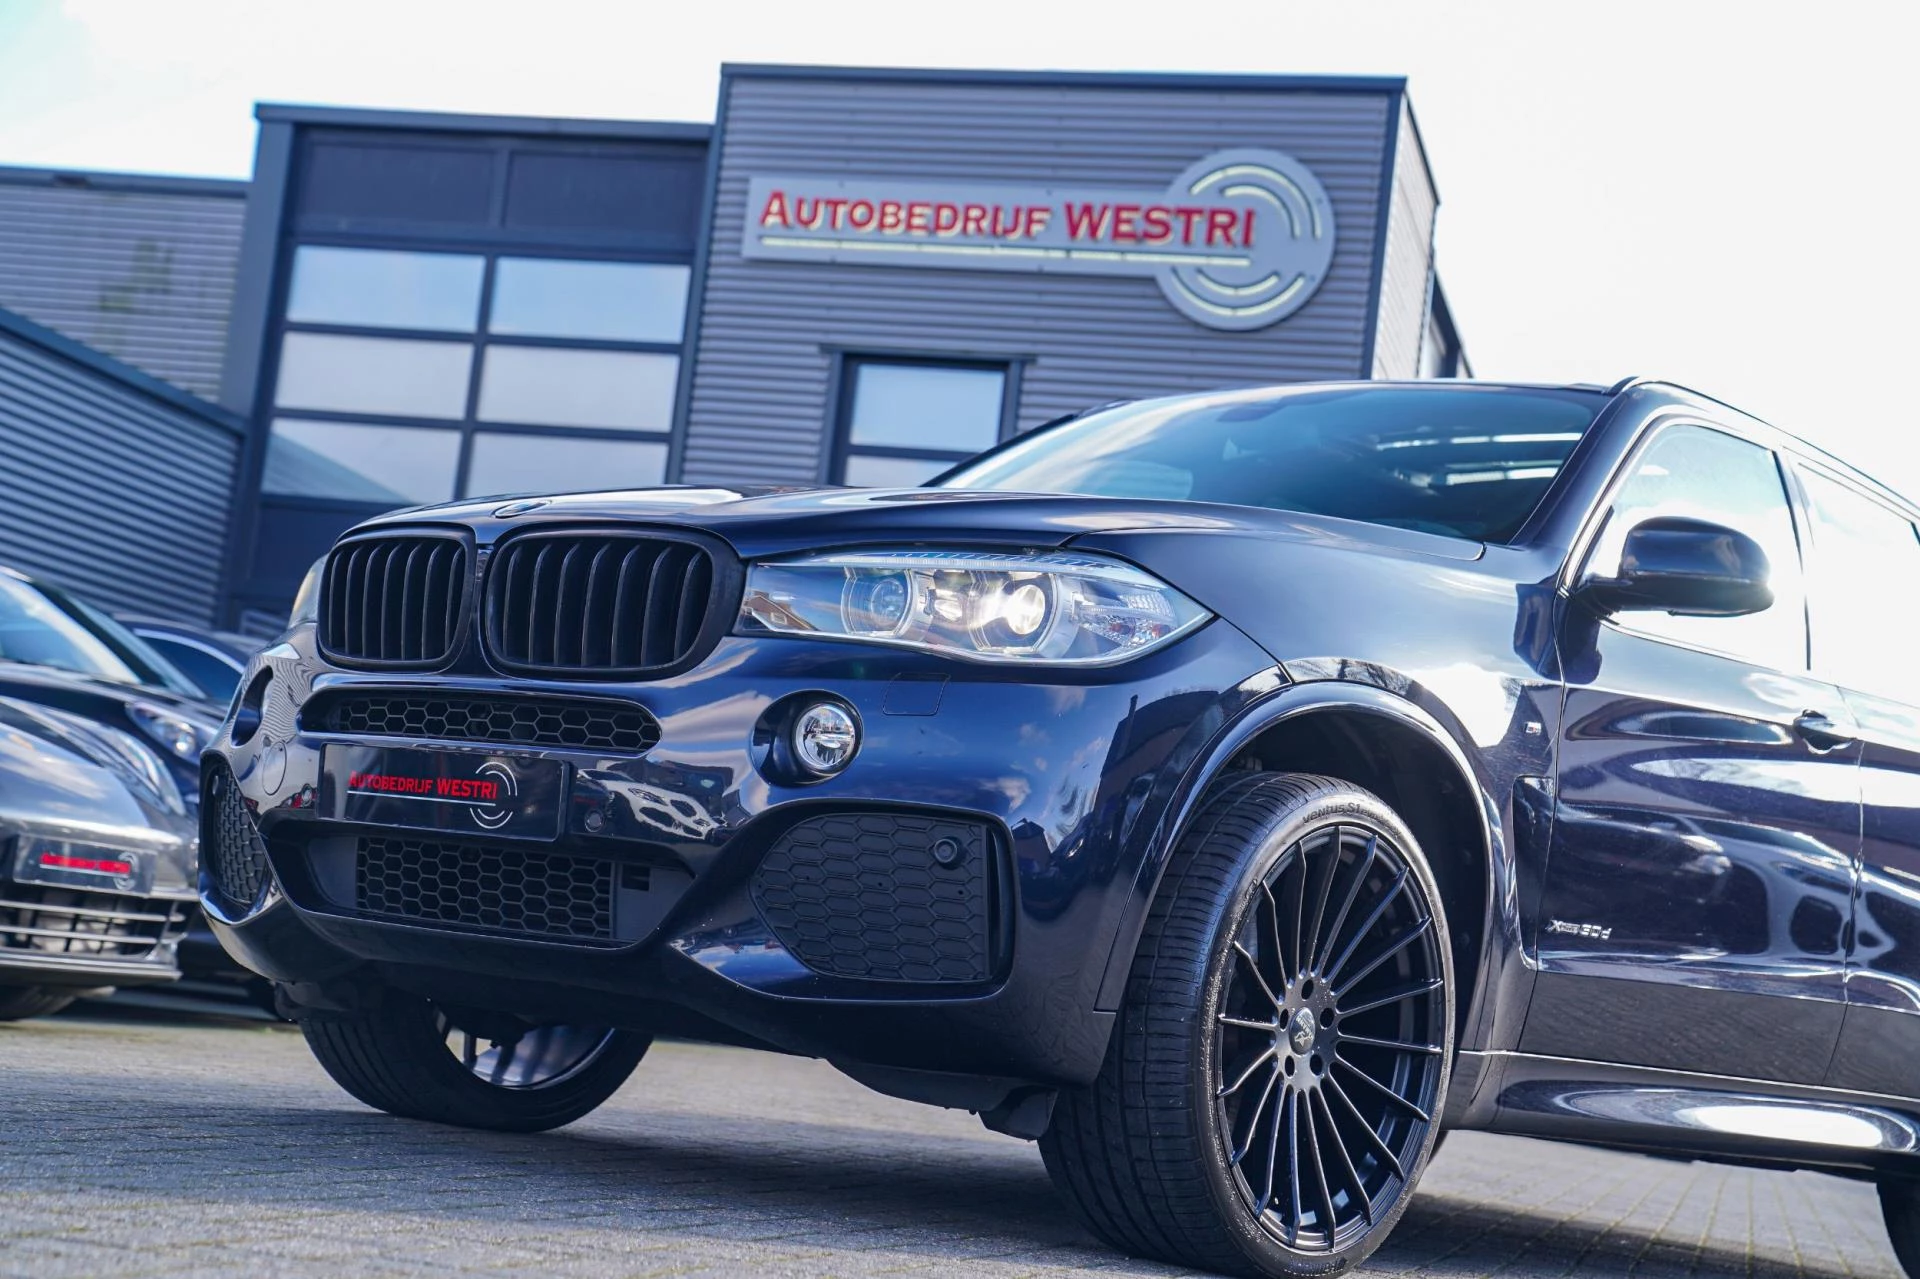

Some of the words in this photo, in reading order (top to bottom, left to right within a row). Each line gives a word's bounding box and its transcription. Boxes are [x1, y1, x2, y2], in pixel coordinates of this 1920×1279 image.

[760, 190, 1051, 241] AUTOBEDRIJF
[1064, 202, 1257, 247] WESTRI
[348, 771, 433, 795] AUTOBEDRIJF
[436, 778, 498, 800] WESTRI
